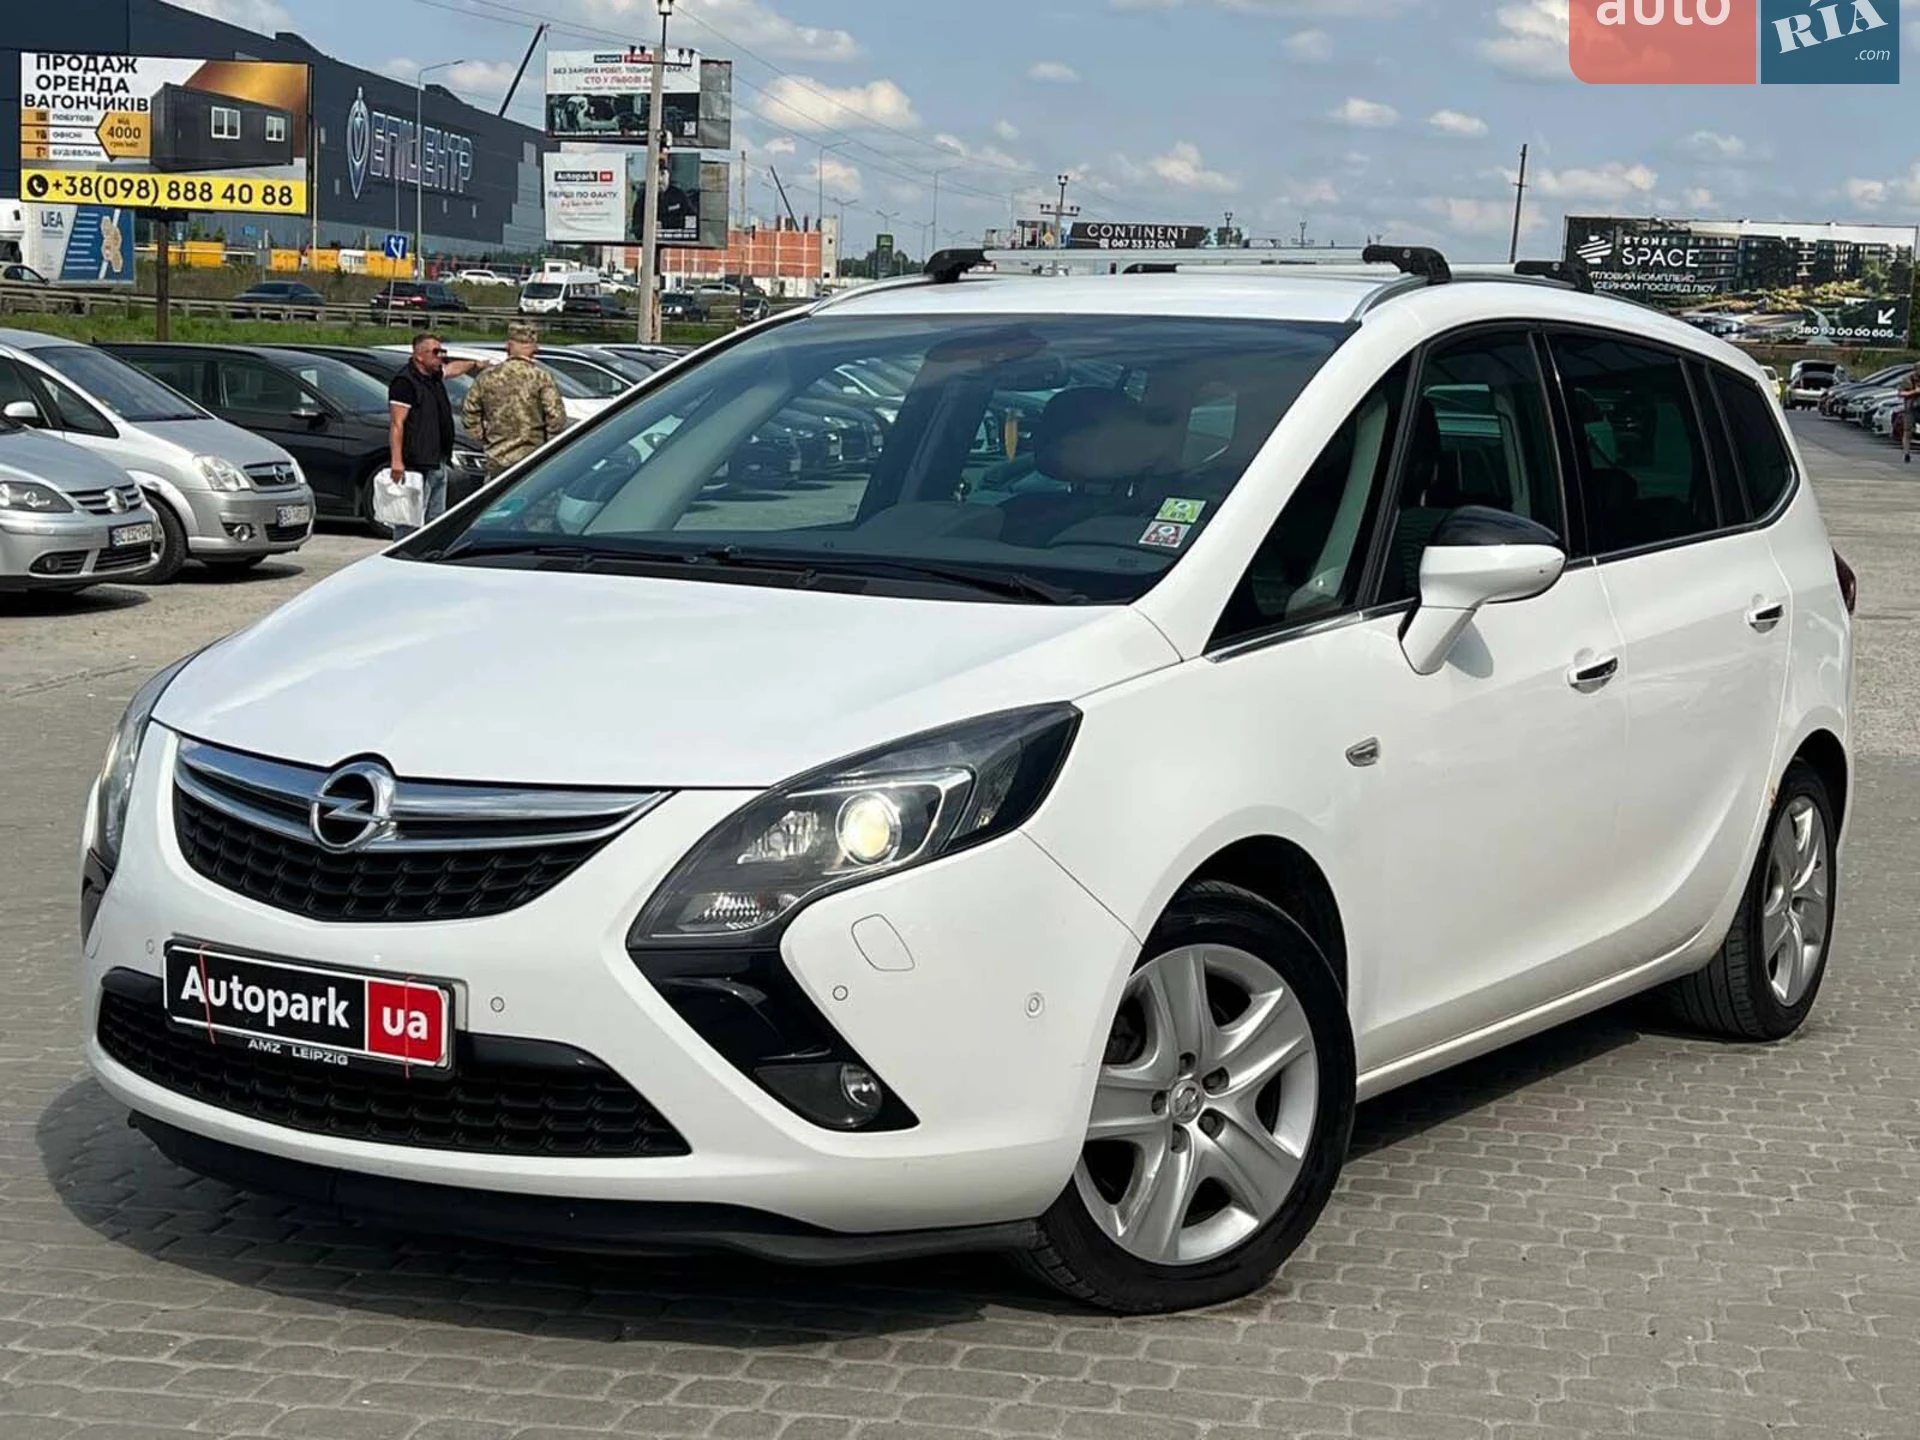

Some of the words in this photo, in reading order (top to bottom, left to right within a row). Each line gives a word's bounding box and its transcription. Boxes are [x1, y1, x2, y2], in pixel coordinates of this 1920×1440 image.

[36, 54, 138, 74] ПРОДАЖ
[36, 74, 130, 95] ОРЕНДА
[24, 94, 150, 112] ВАГОНЧИКІВ
[106, 126, 141, 139] 4000
[557, 172, 596, 181] Autopark
[52, 175, 160, 204] +38(098)
[166, 180, 214, 202] 888
[221, 183, 254, 205] 40
[262, 185, 294, 206] 88
[1087, 224, 1189, 239] CONTINENT
[1622, 247, 1700, 267] SPACE
[181, 965, 350, 1028] Autopark
[382, 1006, 428, 1040] ua
[248, 1039, 282, 1054] AMZ
[292, 1046, 349, 1066] LEIPZIG
